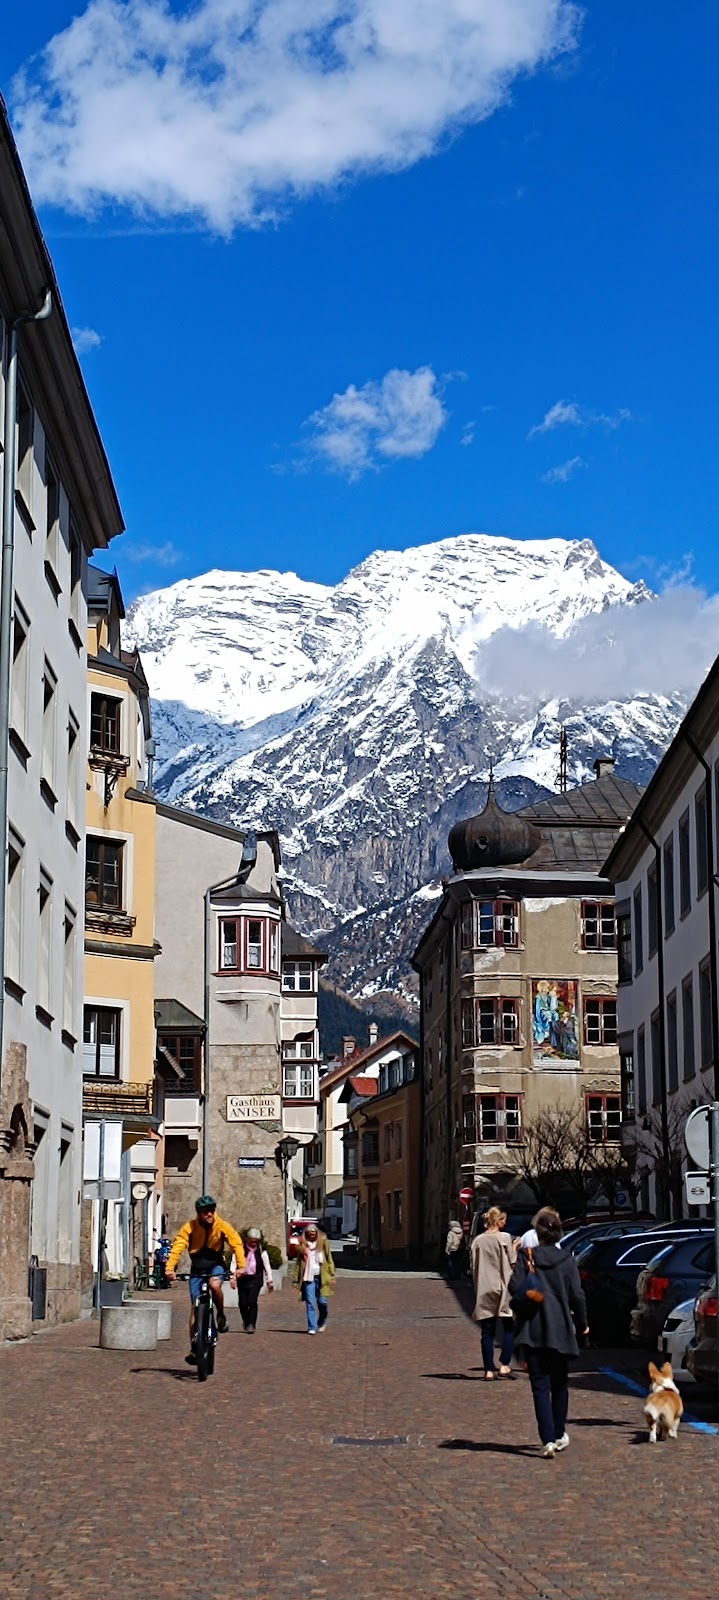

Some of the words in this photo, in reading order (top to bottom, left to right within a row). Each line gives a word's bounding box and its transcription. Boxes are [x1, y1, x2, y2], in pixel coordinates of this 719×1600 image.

[230, 1097, 275, 1107] Gasthaus
[230, 1107, 275, 1117] ANISER
[618, 1194, 625, 1203] P
